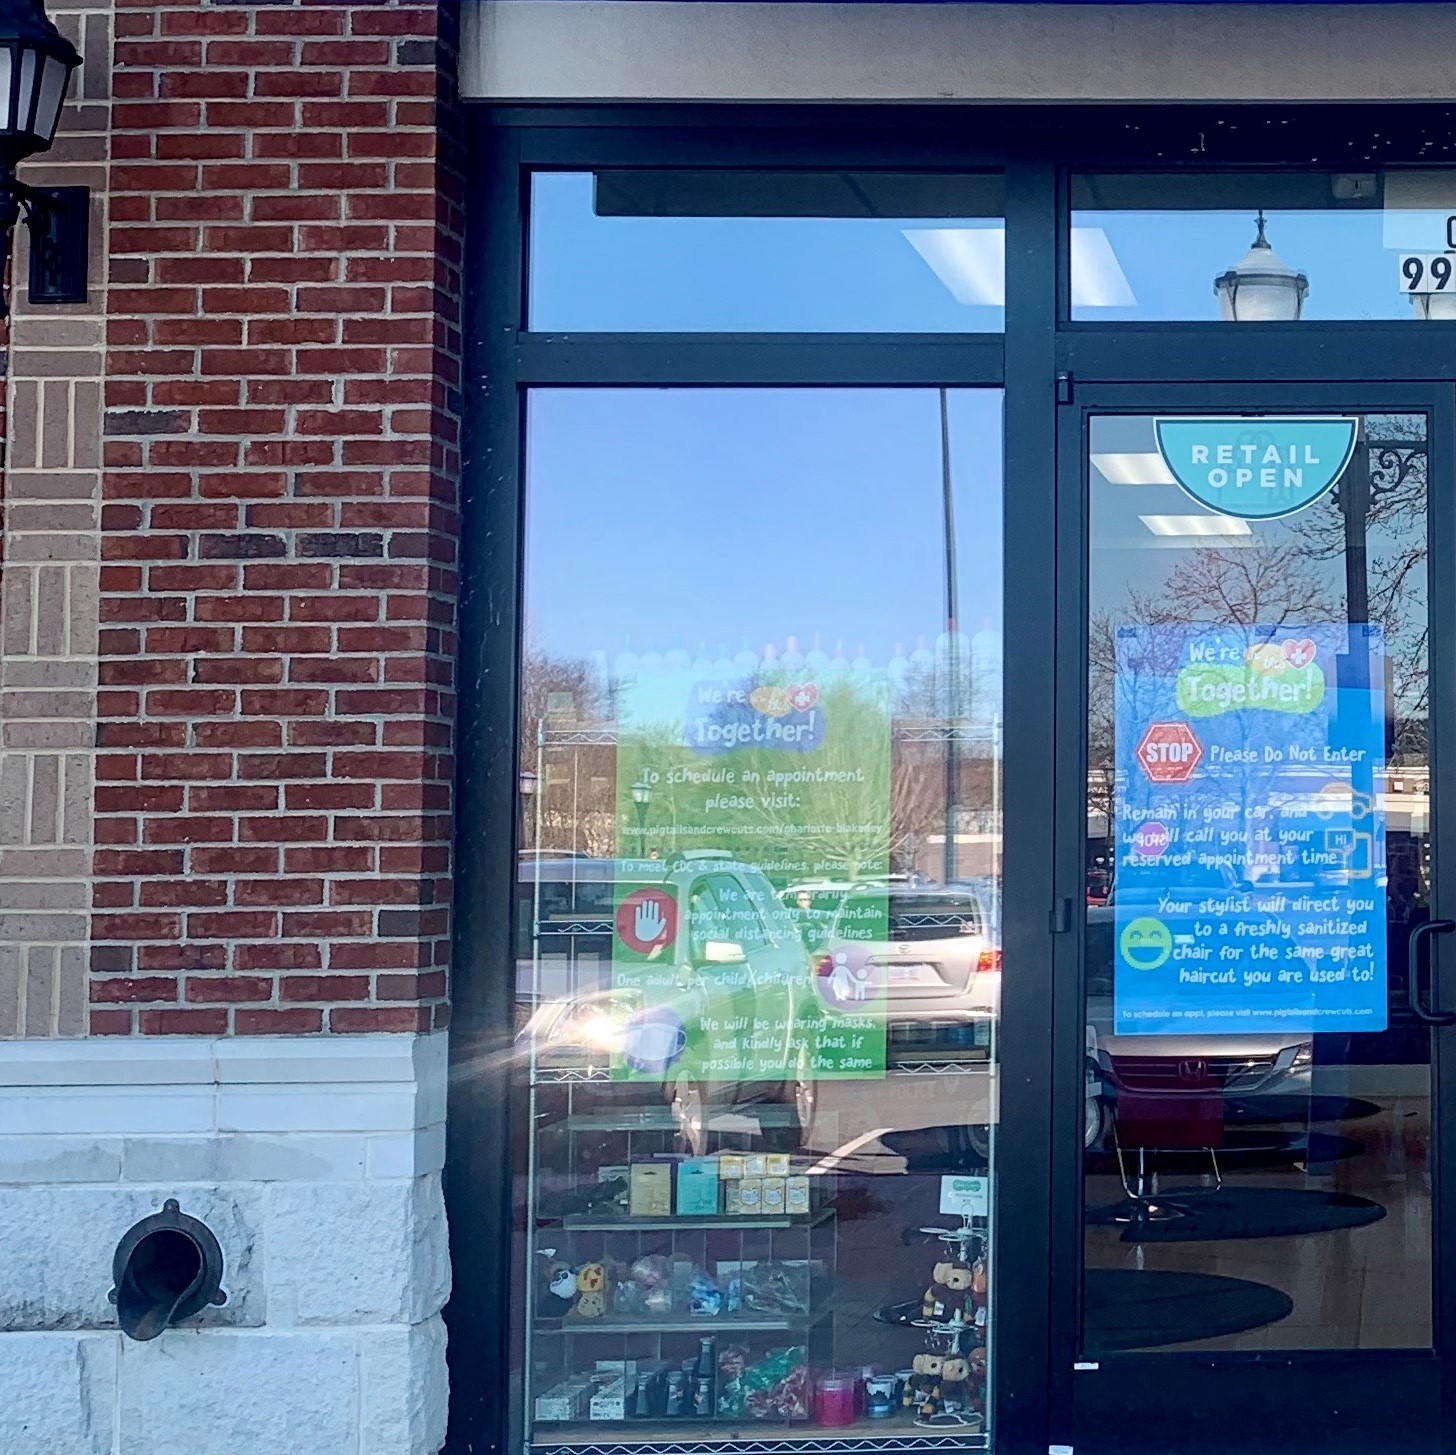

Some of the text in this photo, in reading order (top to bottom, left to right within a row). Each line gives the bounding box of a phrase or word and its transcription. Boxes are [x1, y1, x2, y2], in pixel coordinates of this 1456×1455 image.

[1191, 444, 1320, 464] RETAIL
[1207, 468, 1303, 488] OPEN
[1186, 670, 1312, 707] Together!
[696, 711, 816, 747] Together!
[1146, 742, 1193, 762] STOP
[1210, 746, 1366, 763] Please Do Not Enter
[642, 768, 864, 786] To schedule an appointment
[705, 792, 800, 813] please visit:
[1183, 801, 1196, 819] in
[1203, 808, 1238, 822] your
[1186, 828, 1213, 843] call
[1220, 831, 1248, 846] you
[1254, 828, 1272, 842] at
[1279, 830, 1314, 846] your
[672, 860, 694, 873] CDC
[713, 860, 746, 872] state
[813, 859, 849, 874] please
[1122, 851, 1191, 867] reserved
[1198, 850, 1294, 870] appointment
[719, 888, 738, 902] We
[684, 905, 883, 924] appointment only to maintain
[1158, 896, 1374, 916] Your stylist will direct you
[692, 926, 730, 940] social
[808, 925, 873, 942] guidelines
[1194, 920, 1368, 938] to a freshly sanitized
[1172, 943, 1374, 961] chair for the same great
[617, 974, 640, 986] One
[1179, 962, 1374, 986] haircut you are used to!
[700, 1017, 718, 1031] We
[724, 1016, 748, 1030] will
[753, 1018, 769, 1030] be
[714, 1038, 736, 1050] and
[742, 1036, 782, 1052] kindly
[815, 1035, 846, 1049] that
[852, 1035, 864, 1049] if
[702, 1056, 753, 1074] possible
[760, 1059, 784, 1071] you
[811, 1055, 833, 1069] the
[839, 1057, 872, 1069] same
